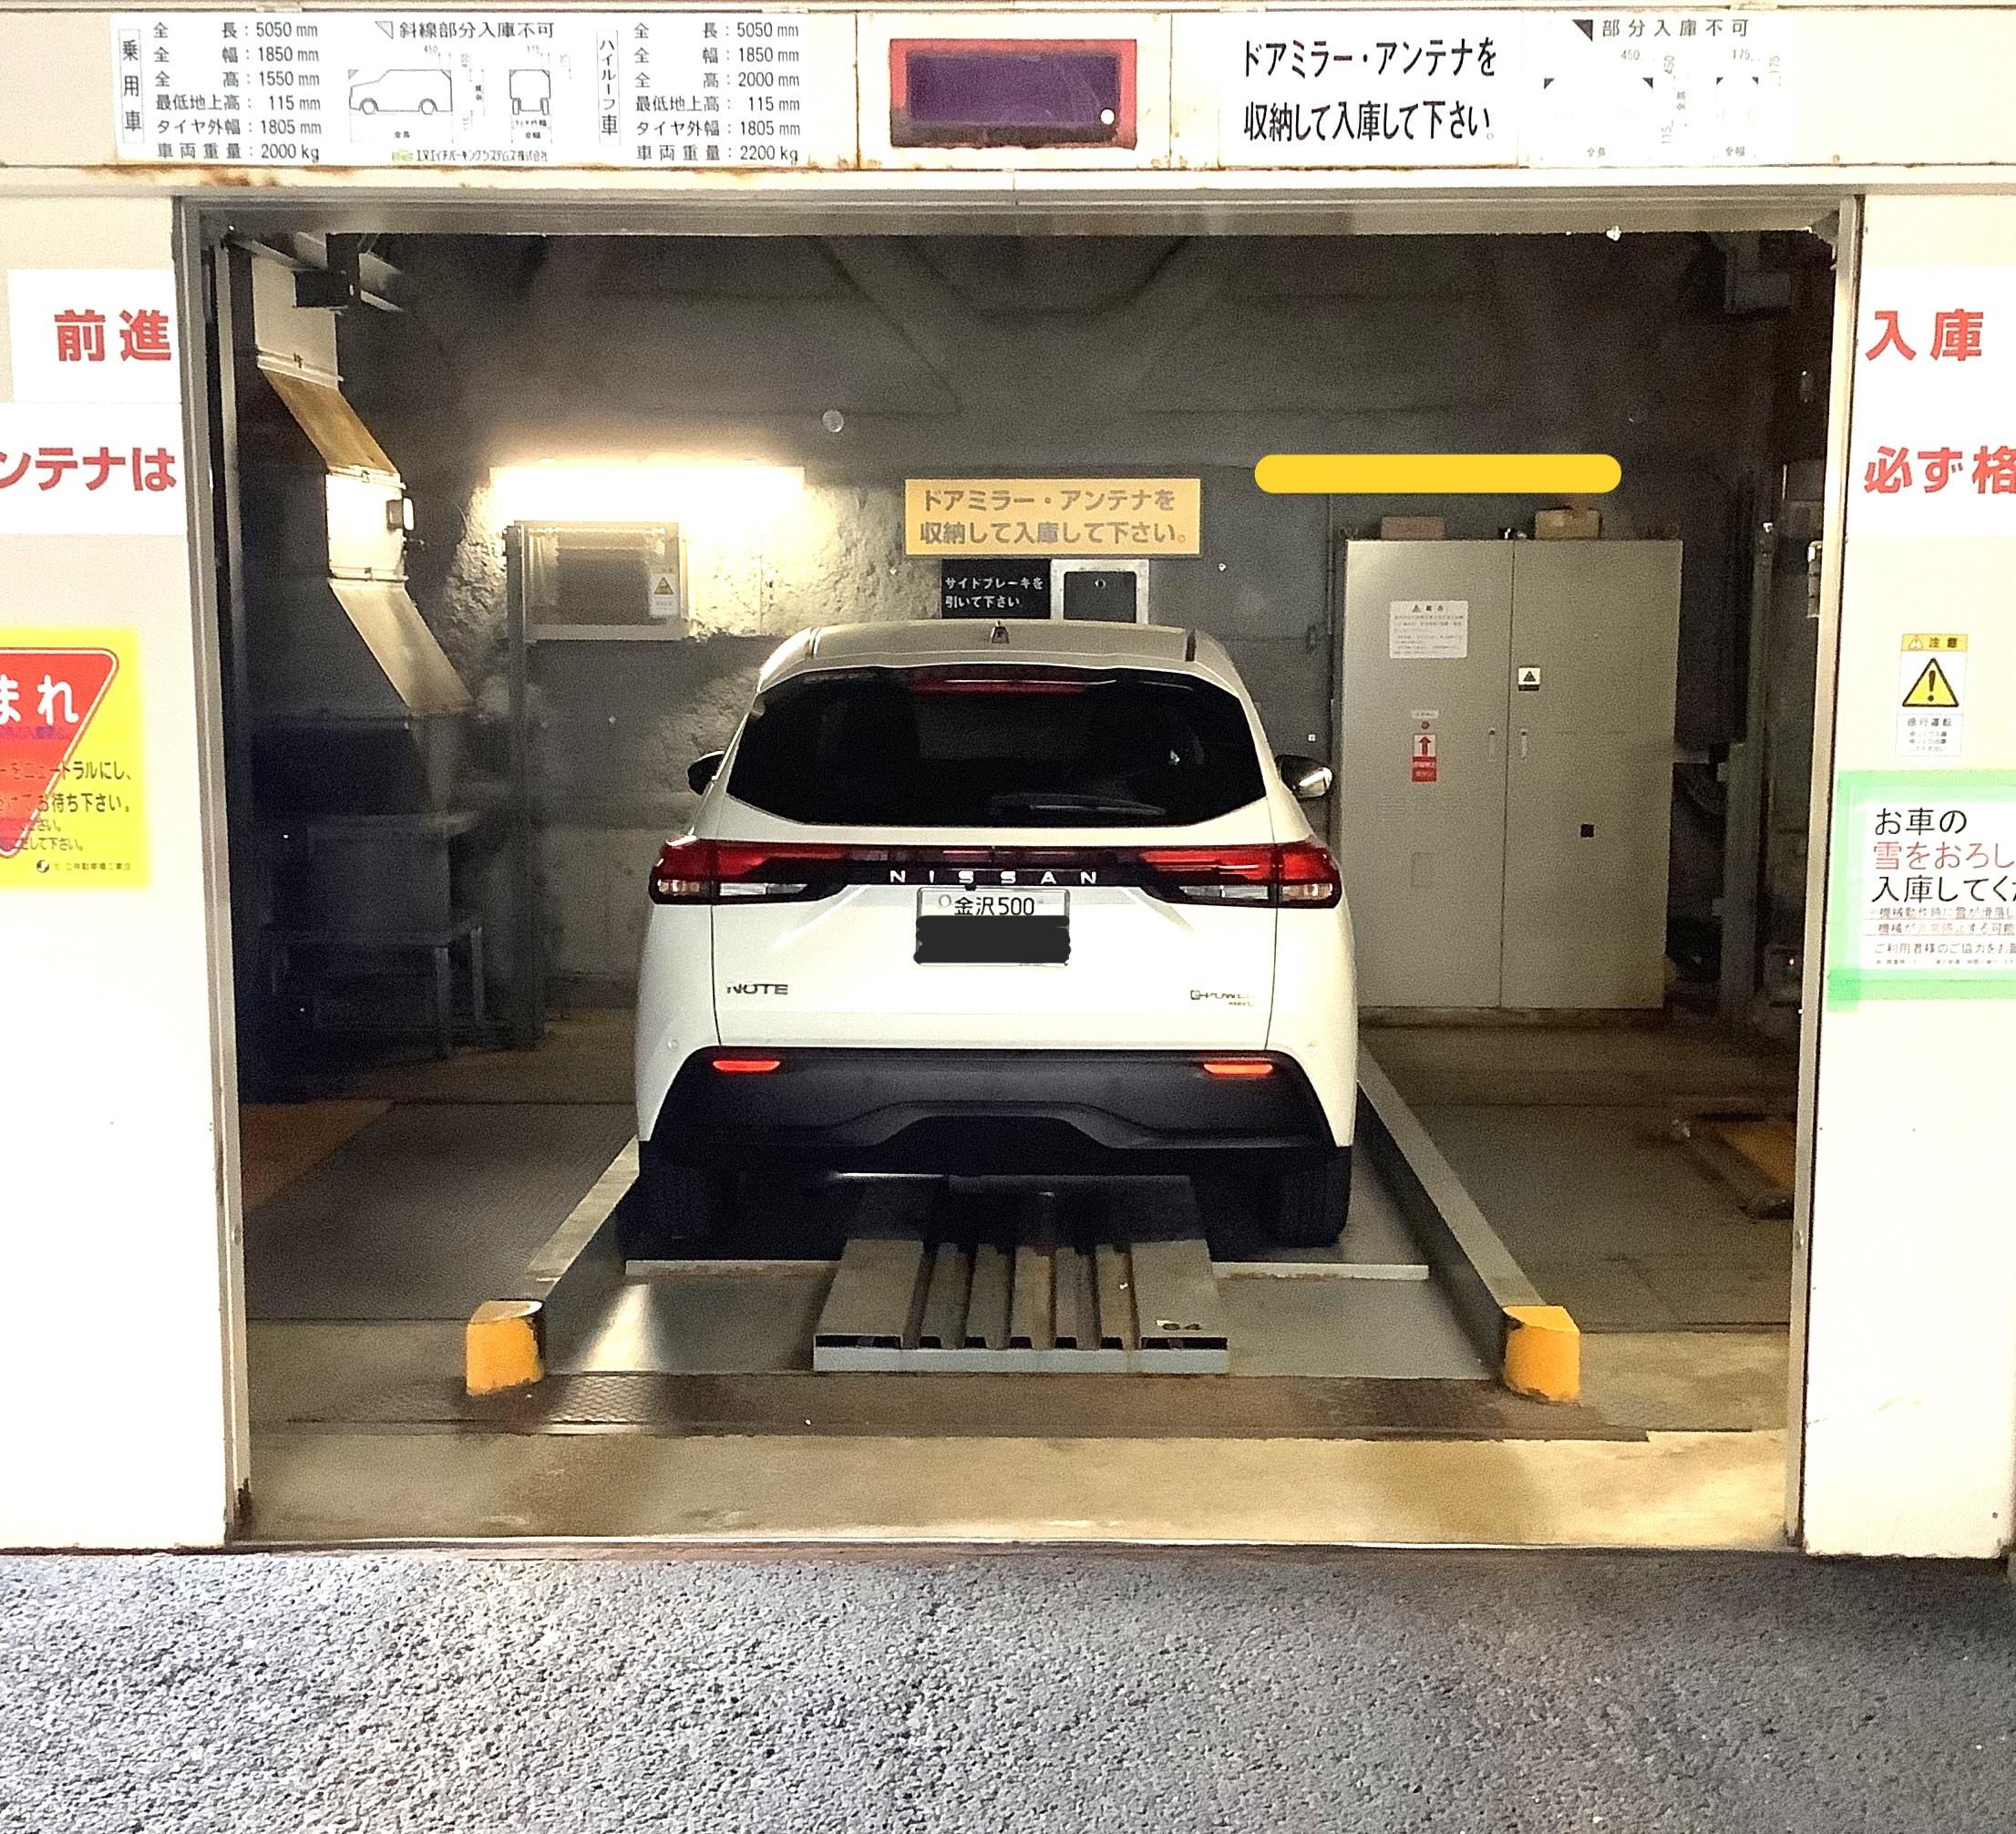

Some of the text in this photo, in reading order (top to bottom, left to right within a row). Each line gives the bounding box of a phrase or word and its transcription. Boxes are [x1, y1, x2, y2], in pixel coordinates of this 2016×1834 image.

[255, 21, 293, 37] 5050
[296, 25, 318, 37] mm
[399, 21, 555, 39] 斜線部分入庫不可
[736, 21, 773, 38] 5050
[777, 26, 799, 37] mm
[1602, 18, 1749, 37] 部分入庫不可
[258, 46, 293, 62] 1850
[297, 50, 320, 62] mm
[738, 46, 774, 63] 1850
[777, 50, 799, 62] mm
[1245, 36, 1497, 79] ドアミラー・アンテナを
[122, 39, 142, 132] 乗用車
[259, 70, 294, 87] 1550
[298, 74, 320, 87] mm
[599, 38, 620, 136] ハイルーフ車
[737, 71, 774, 88] 2000
[777, 75, 800, 87] mm
[269, 95, 295, 110] 115
[299, 98, 321, 110] mm
[748, 96, 775, 112] 115
[778, 99, 800, 111] mm
[261, 118, 296, 135] 1805
[300, 123, 322, 134] mm
[740, 119, 775, 136] 1805
[779, 124, 800, 136] mm
[261, 143, 297, 160] 2000
[301, 143, 320, 163] kg
[740, 144, 776, 160] 2200
[780, 145, 798, 164] kg
[54, 308, 172, 362] 前進
[1865, 308, 1984, 361] 入庫
[0, 446, 177, 491] ンテナは
[1864, 445, 2016, 494] 必ず格
[924, 489, 1176, 511] ドアミラー・アンテナを
[919, 520, 1187, 546] 収納して入庫して下さい。
[945, 595, 1021, 608] 引いて下さい
[1874, 807, 1968, 836] お車の
[1873, 840, 2015, 870] 雪をおろし
[890, 869, 1097, 884] NISSAN
[1871, 874, 2016, 903] 入庫してく
[726, 983, 788, 994] NOTE
